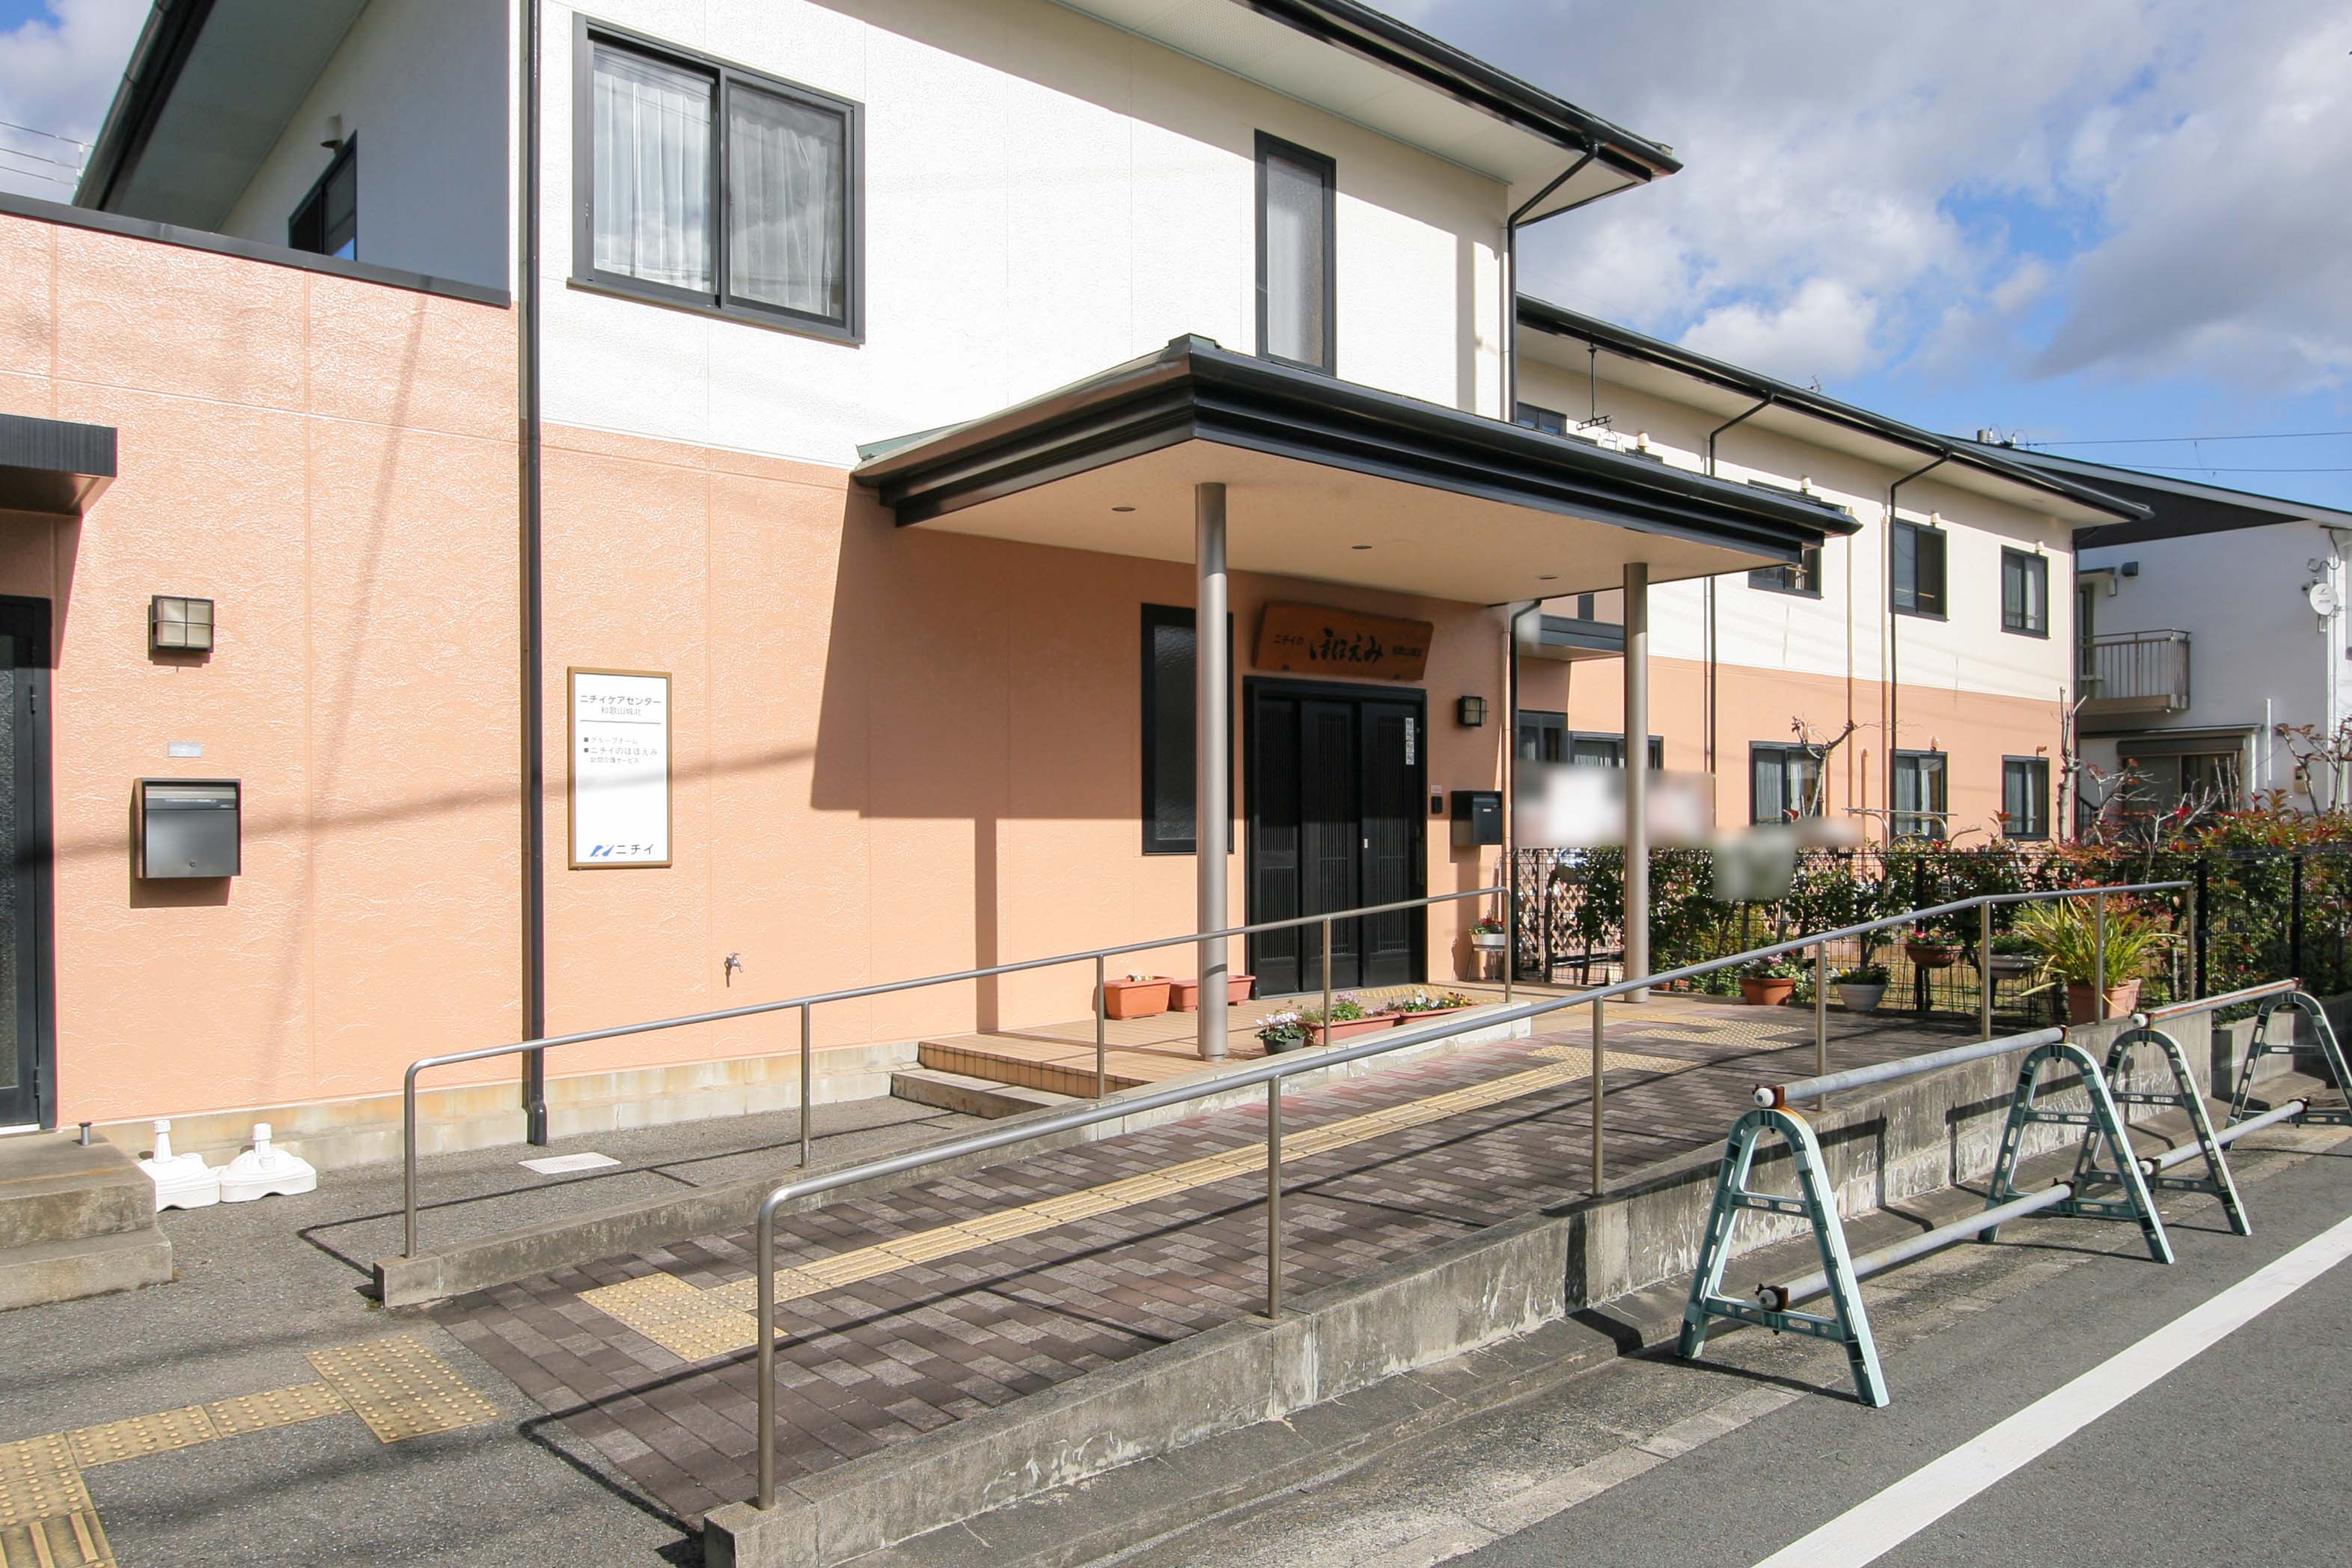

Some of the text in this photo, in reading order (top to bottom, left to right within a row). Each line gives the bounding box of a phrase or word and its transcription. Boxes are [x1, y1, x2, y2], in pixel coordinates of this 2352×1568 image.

[580, 695, 662, 706] ニチイケアセンター
[616, 843, 654, 855] ニチイ
